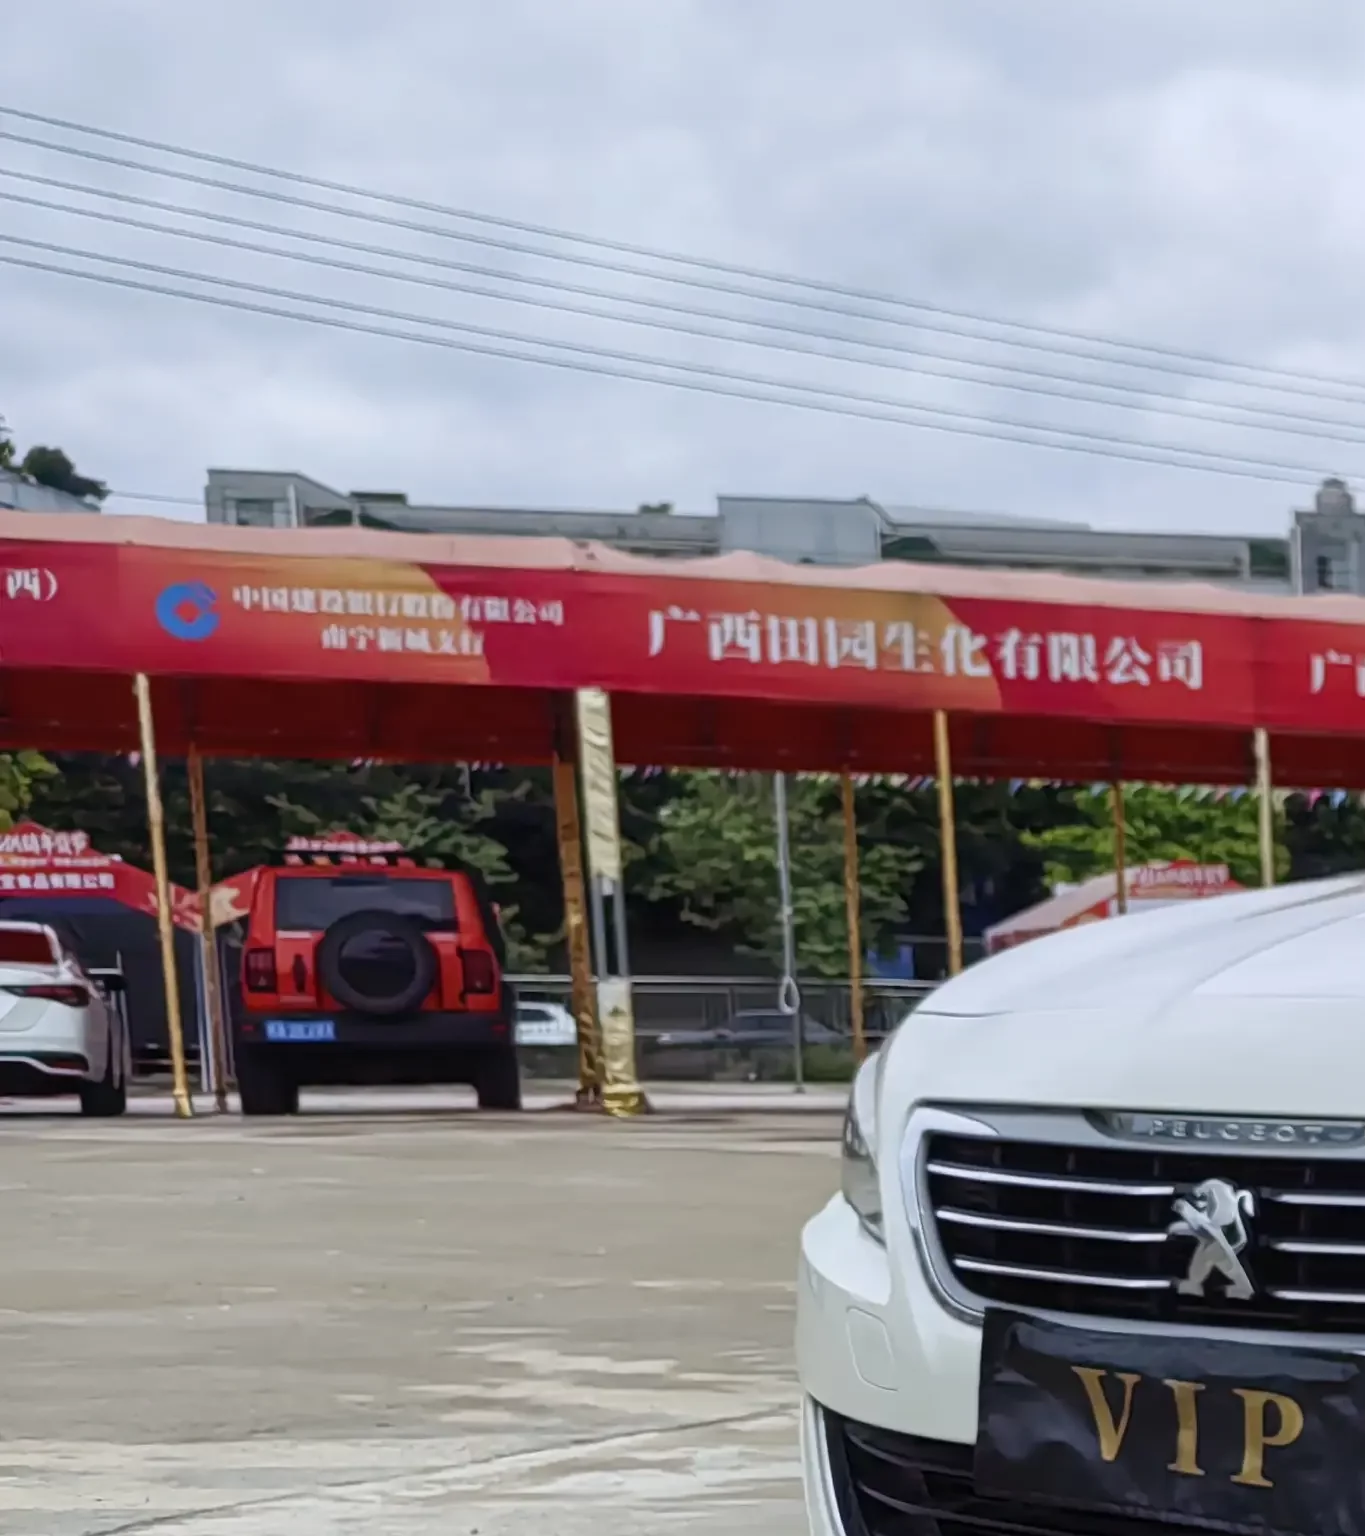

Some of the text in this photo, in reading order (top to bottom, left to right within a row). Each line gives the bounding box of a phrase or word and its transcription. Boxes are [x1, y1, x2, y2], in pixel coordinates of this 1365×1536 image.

[647, 605, 1204, 690] 广西田园生化有限公司
[1149, 1118, 1324, 1144] PEUGEOT
[1071, 1364, 1305, 1488] VIP
